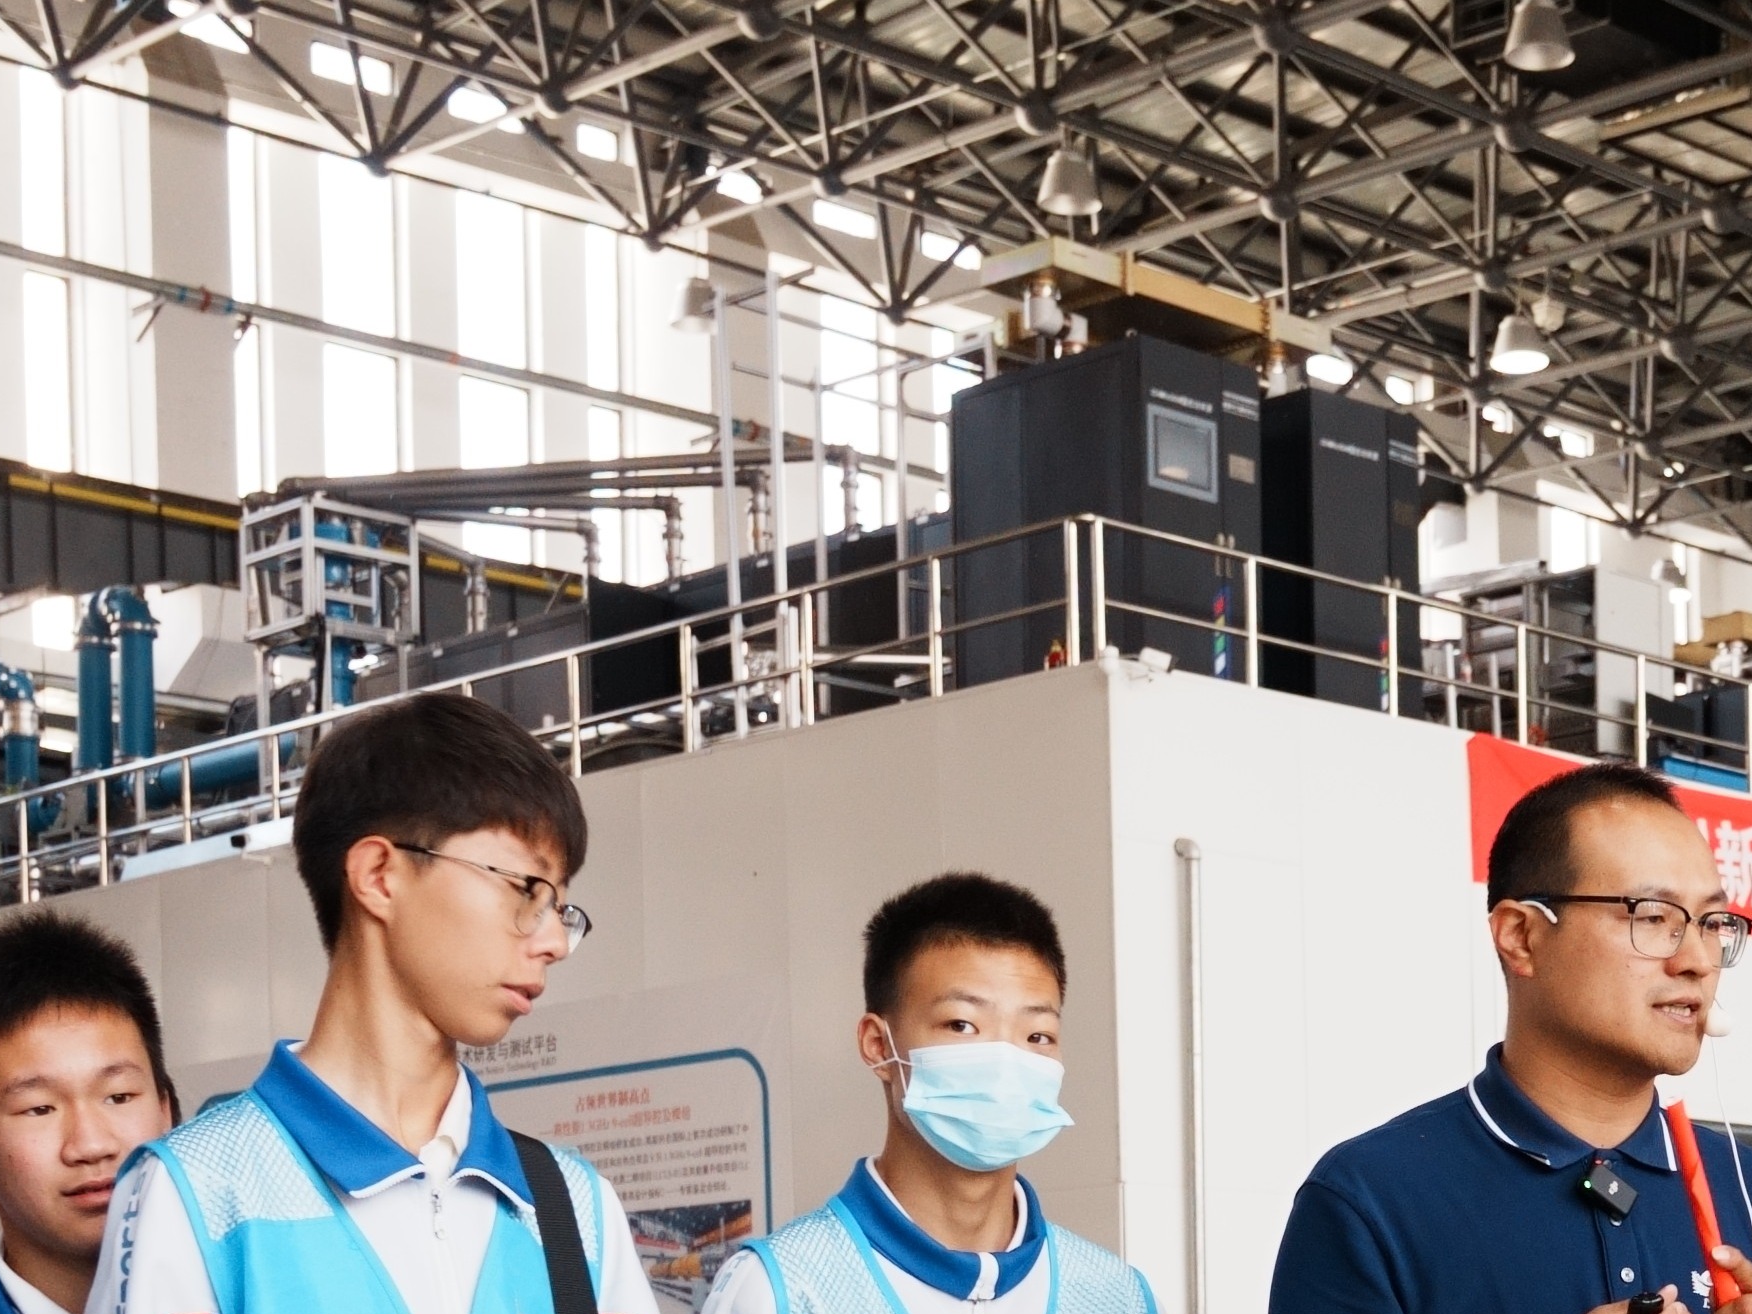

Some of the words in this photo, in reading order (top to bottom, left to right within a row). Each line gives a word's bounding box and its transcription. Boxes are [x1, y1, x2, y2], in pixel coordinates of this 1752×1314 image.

[457, 1033, 557, 1064] 术研发与测试平台
